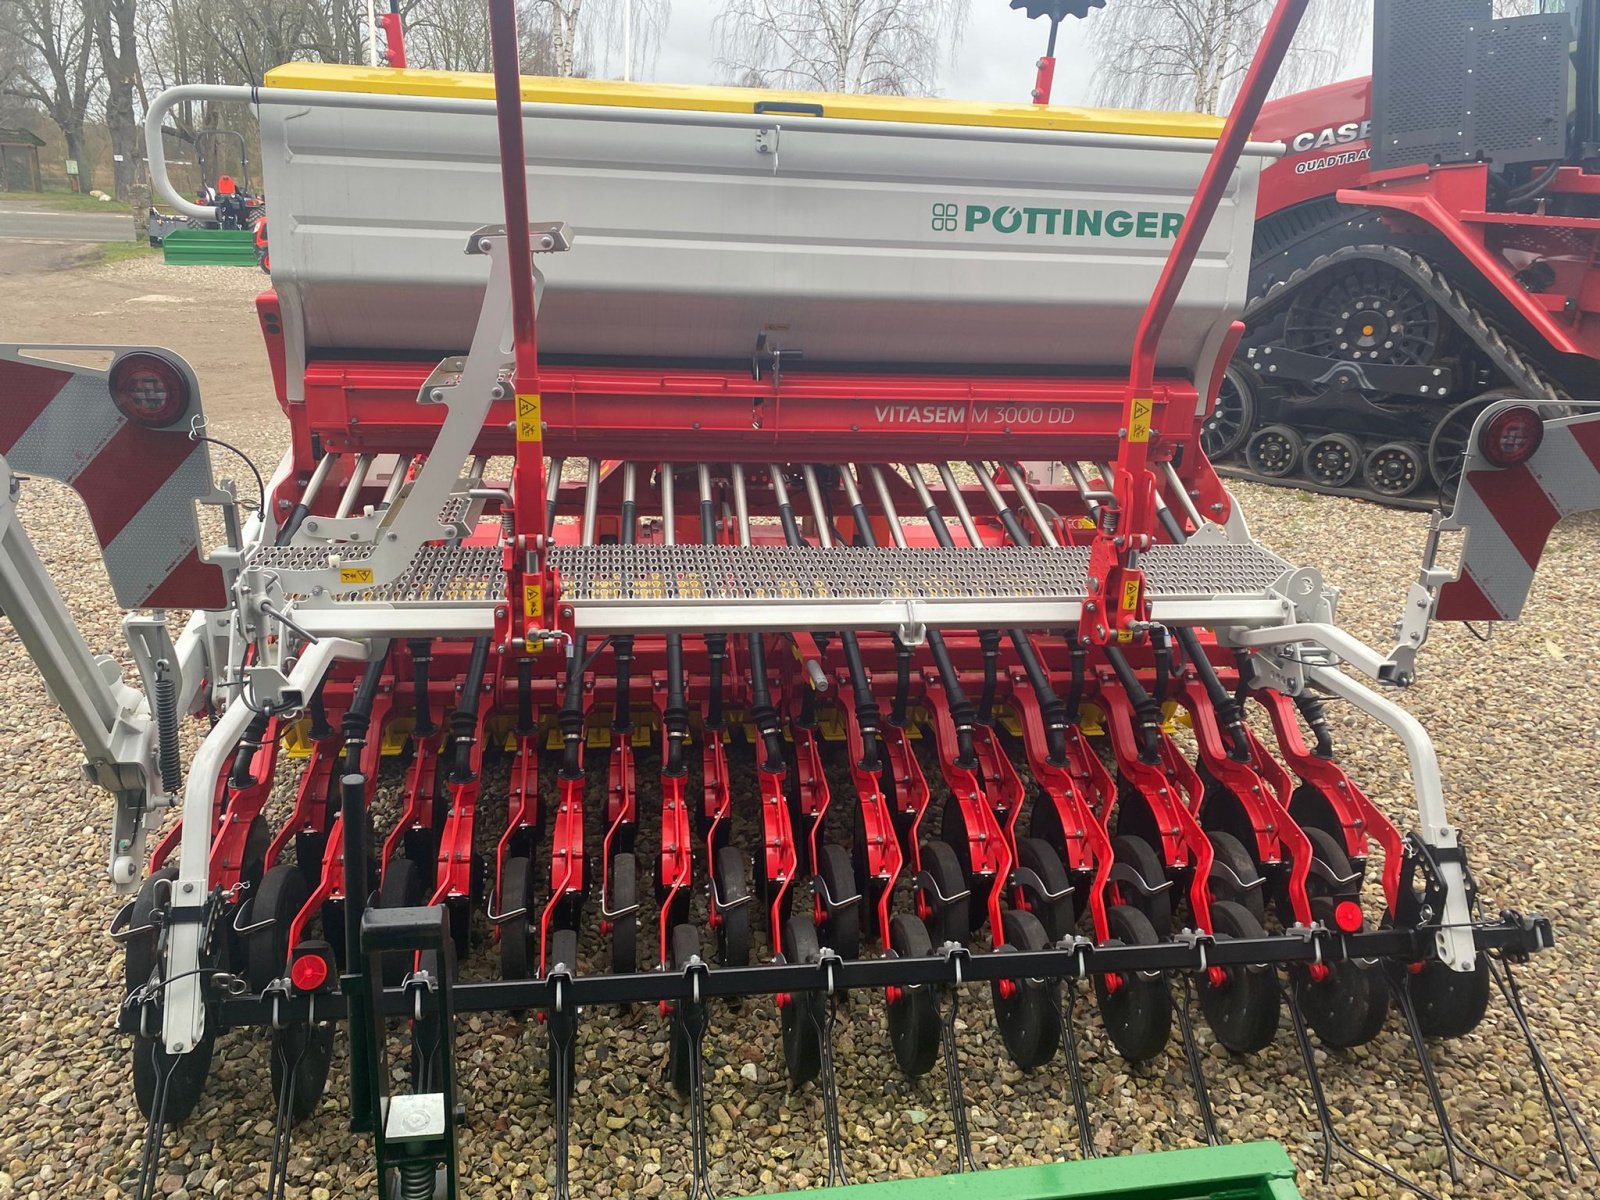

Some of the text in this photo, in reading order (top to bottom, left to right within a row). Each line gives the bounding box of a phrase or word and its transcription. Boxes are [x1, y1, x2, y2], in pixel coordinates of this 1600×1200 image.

[874, 405, 1075, 424] VITASEM M 3000 DD
